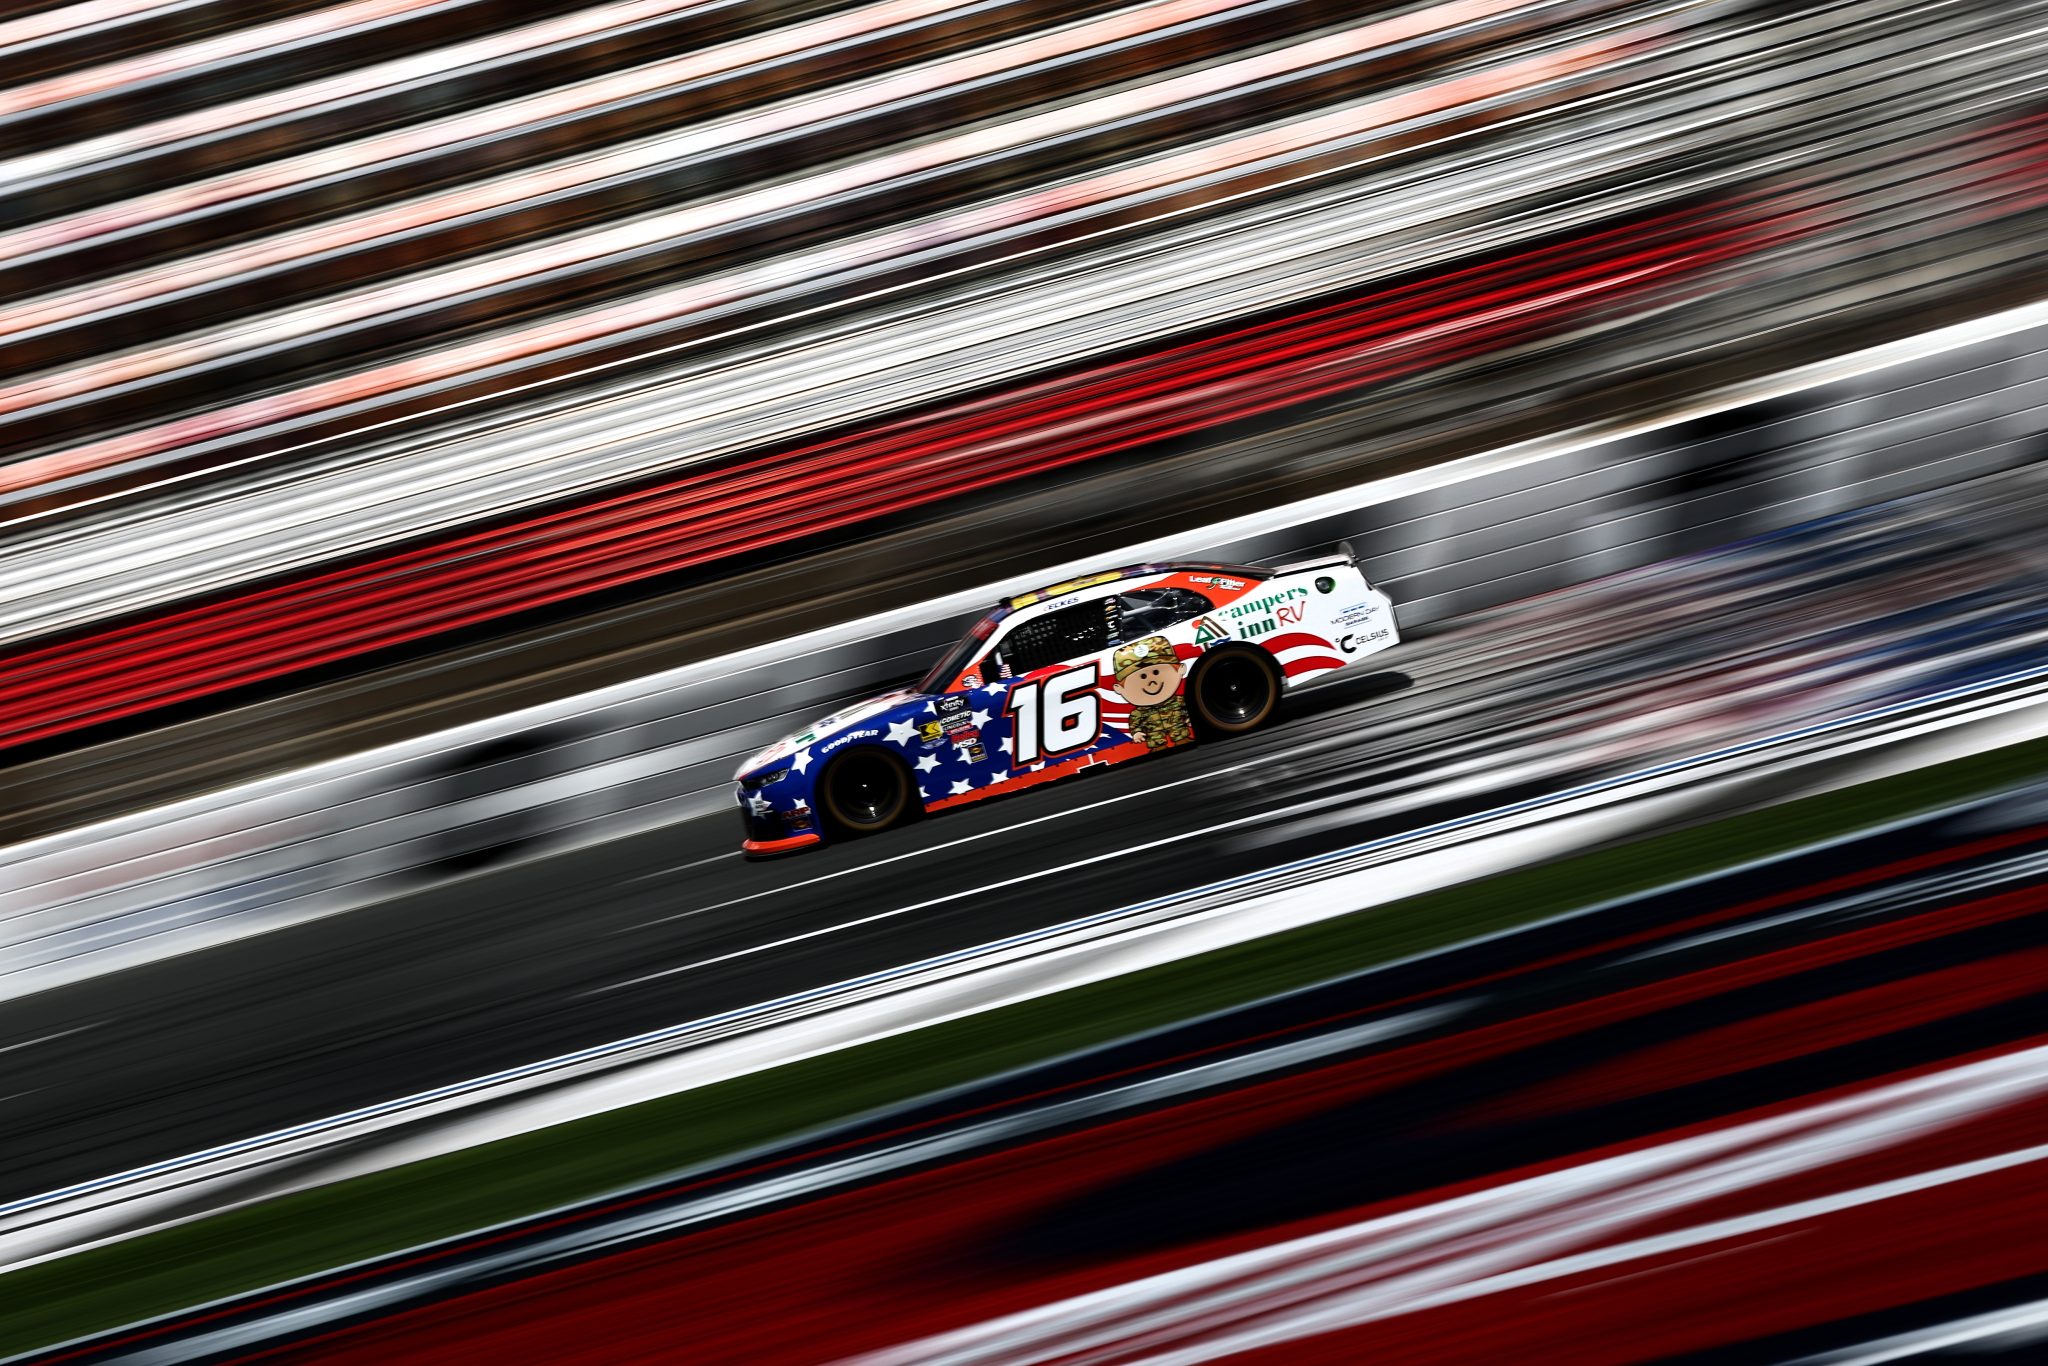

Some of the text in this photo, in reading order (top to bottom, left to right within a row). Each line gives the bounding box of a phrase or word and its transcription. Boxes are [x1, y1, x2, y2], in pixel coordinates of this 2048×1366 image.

[1048, 597, 1079, 610] ECKES
[1238, 601, 1306, 640] inn RV
[1356, 629, 1389, 645] CELSIUS
[941, 710, 972, 724] COMETIC
[1006, 663, 1098, 766] 16
[821, 729, 879, 753] GOODYEAR
[952, 738, 977, 750] MSD
